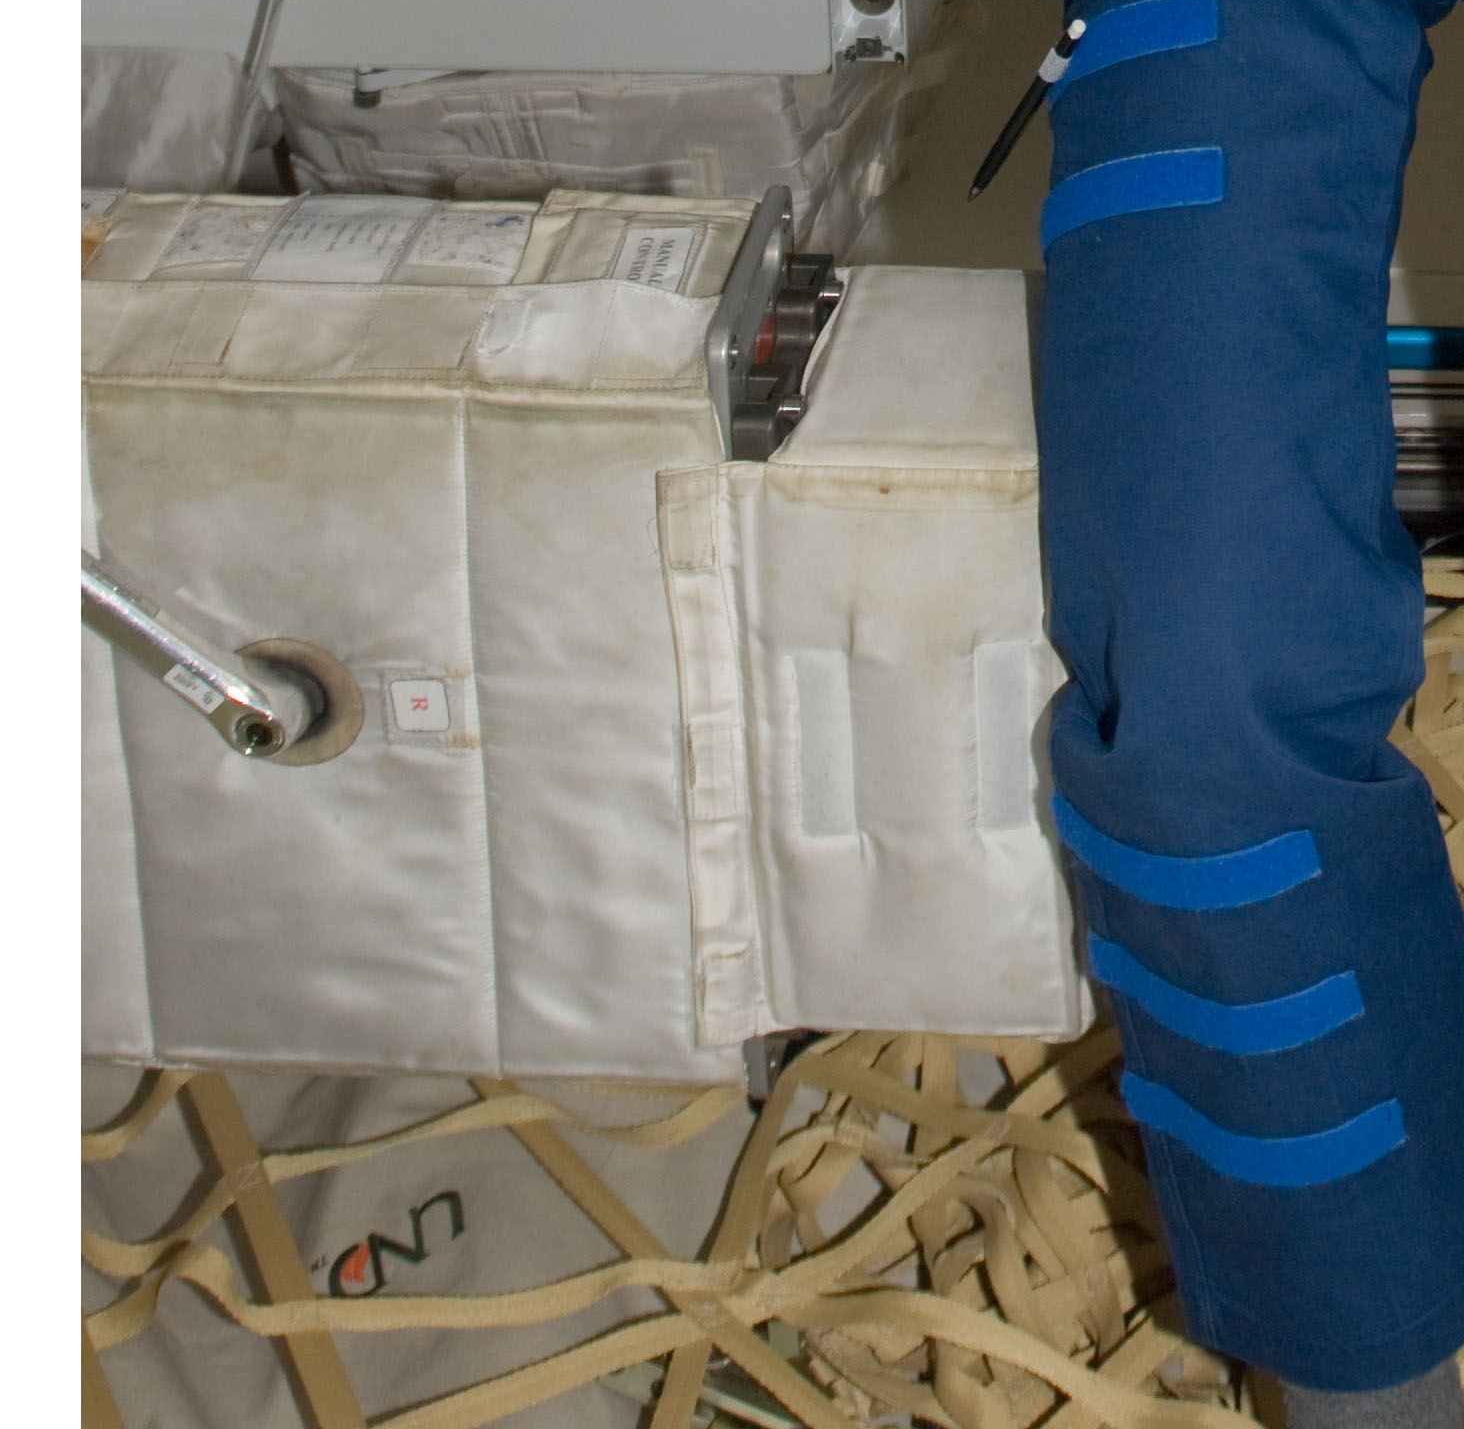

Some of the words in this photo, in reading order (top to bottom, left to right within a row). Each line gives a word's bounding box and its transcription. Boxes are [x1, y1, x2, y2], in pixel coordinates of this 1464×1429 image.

[627, 237, 654, 284] CONTRO
[647, 239, 675, 286] MANUAL
[410, 696, 429, 713] R
